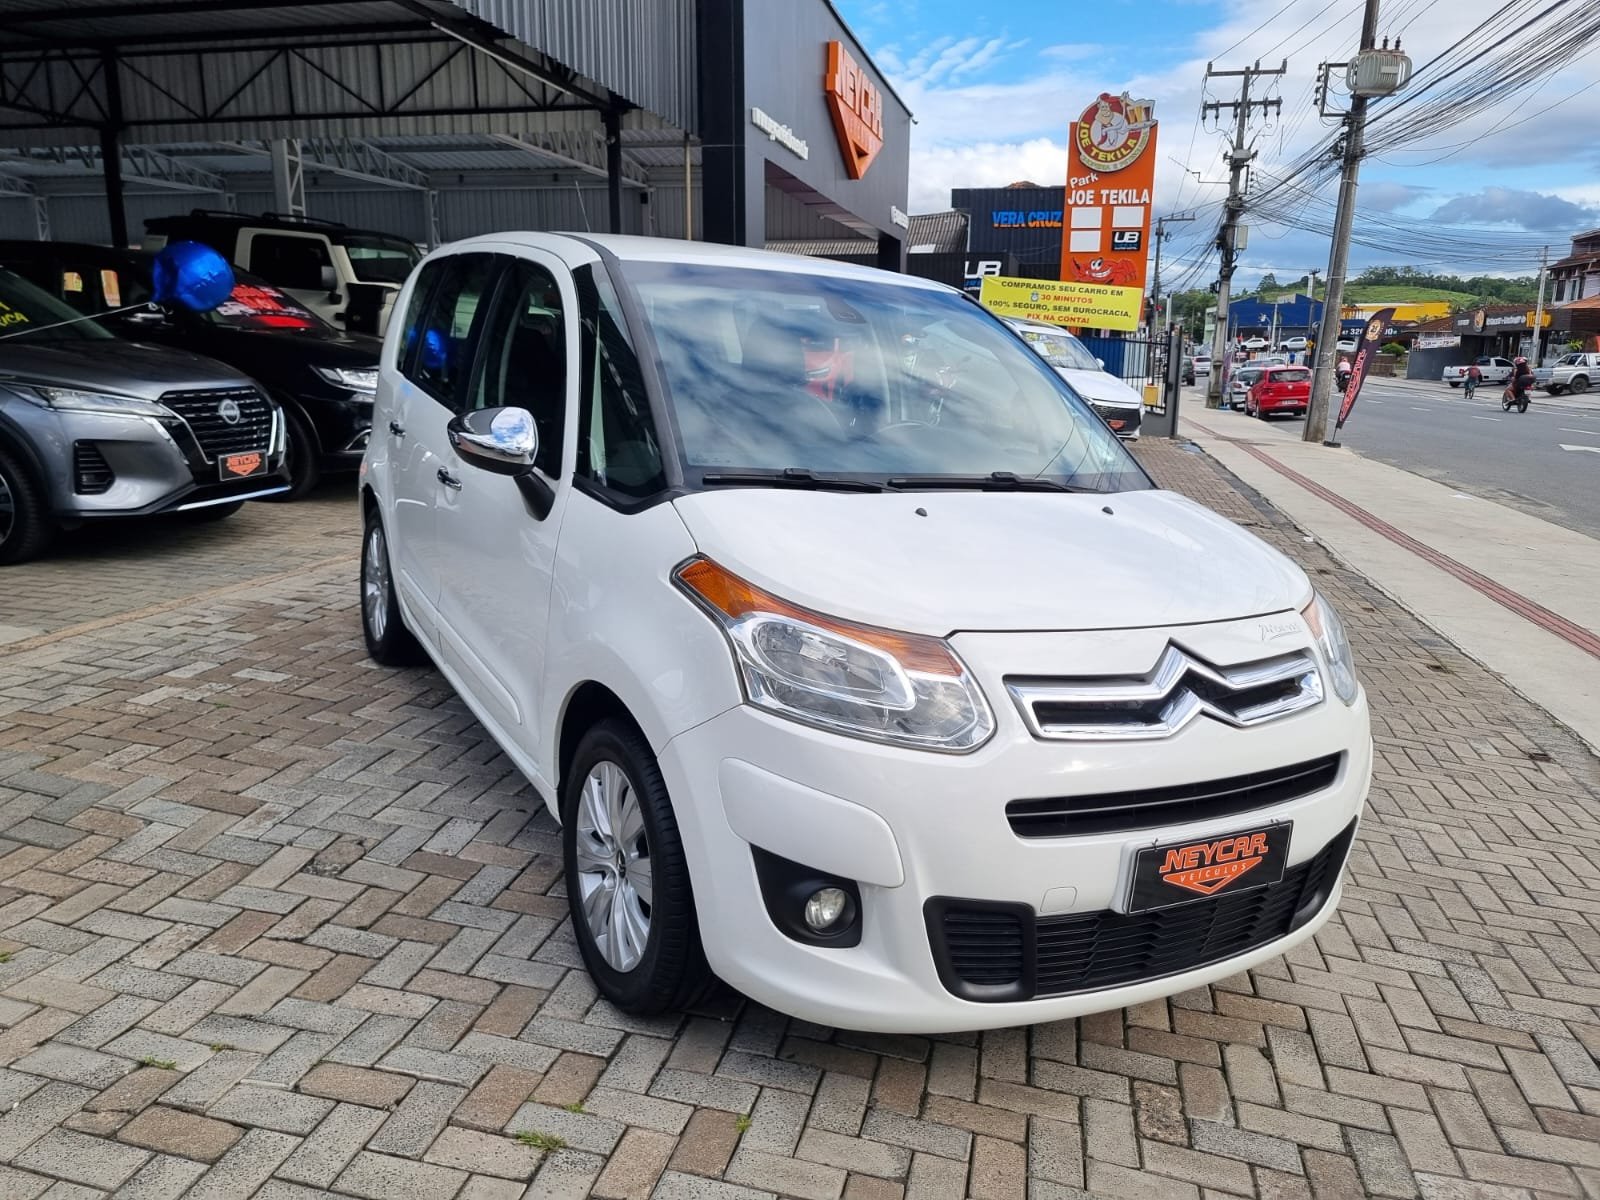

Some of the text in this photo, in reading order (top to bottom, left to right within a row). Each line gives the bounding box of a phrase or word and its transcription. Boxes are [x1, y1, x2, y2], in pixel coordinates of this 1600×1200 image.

[1079, 121, 1092, 148] JOE
[1089, 138, 1137, 162] TEKILA
[1069, 172, 1099, 188] Park
[1067, 188, 1150, 205] JOE TEKILA
[991, 211, 1063, 228] VERA CRUZ
[1114, 231, 1140, 243] UB
[964, 261, 1002, 279] UB
[1001, 280, 1124, 297] COMPRAMOS SEU CARRO EM
[988, 300, 1010, 308] 100%
[1012, 302, 1050, 312] SEGURO,
[1053, 294, 1093, 304] MINUTOS
[1026, 313, 1041, 321] PIX
[1159, 832, 1269, 873] NEYCAR
